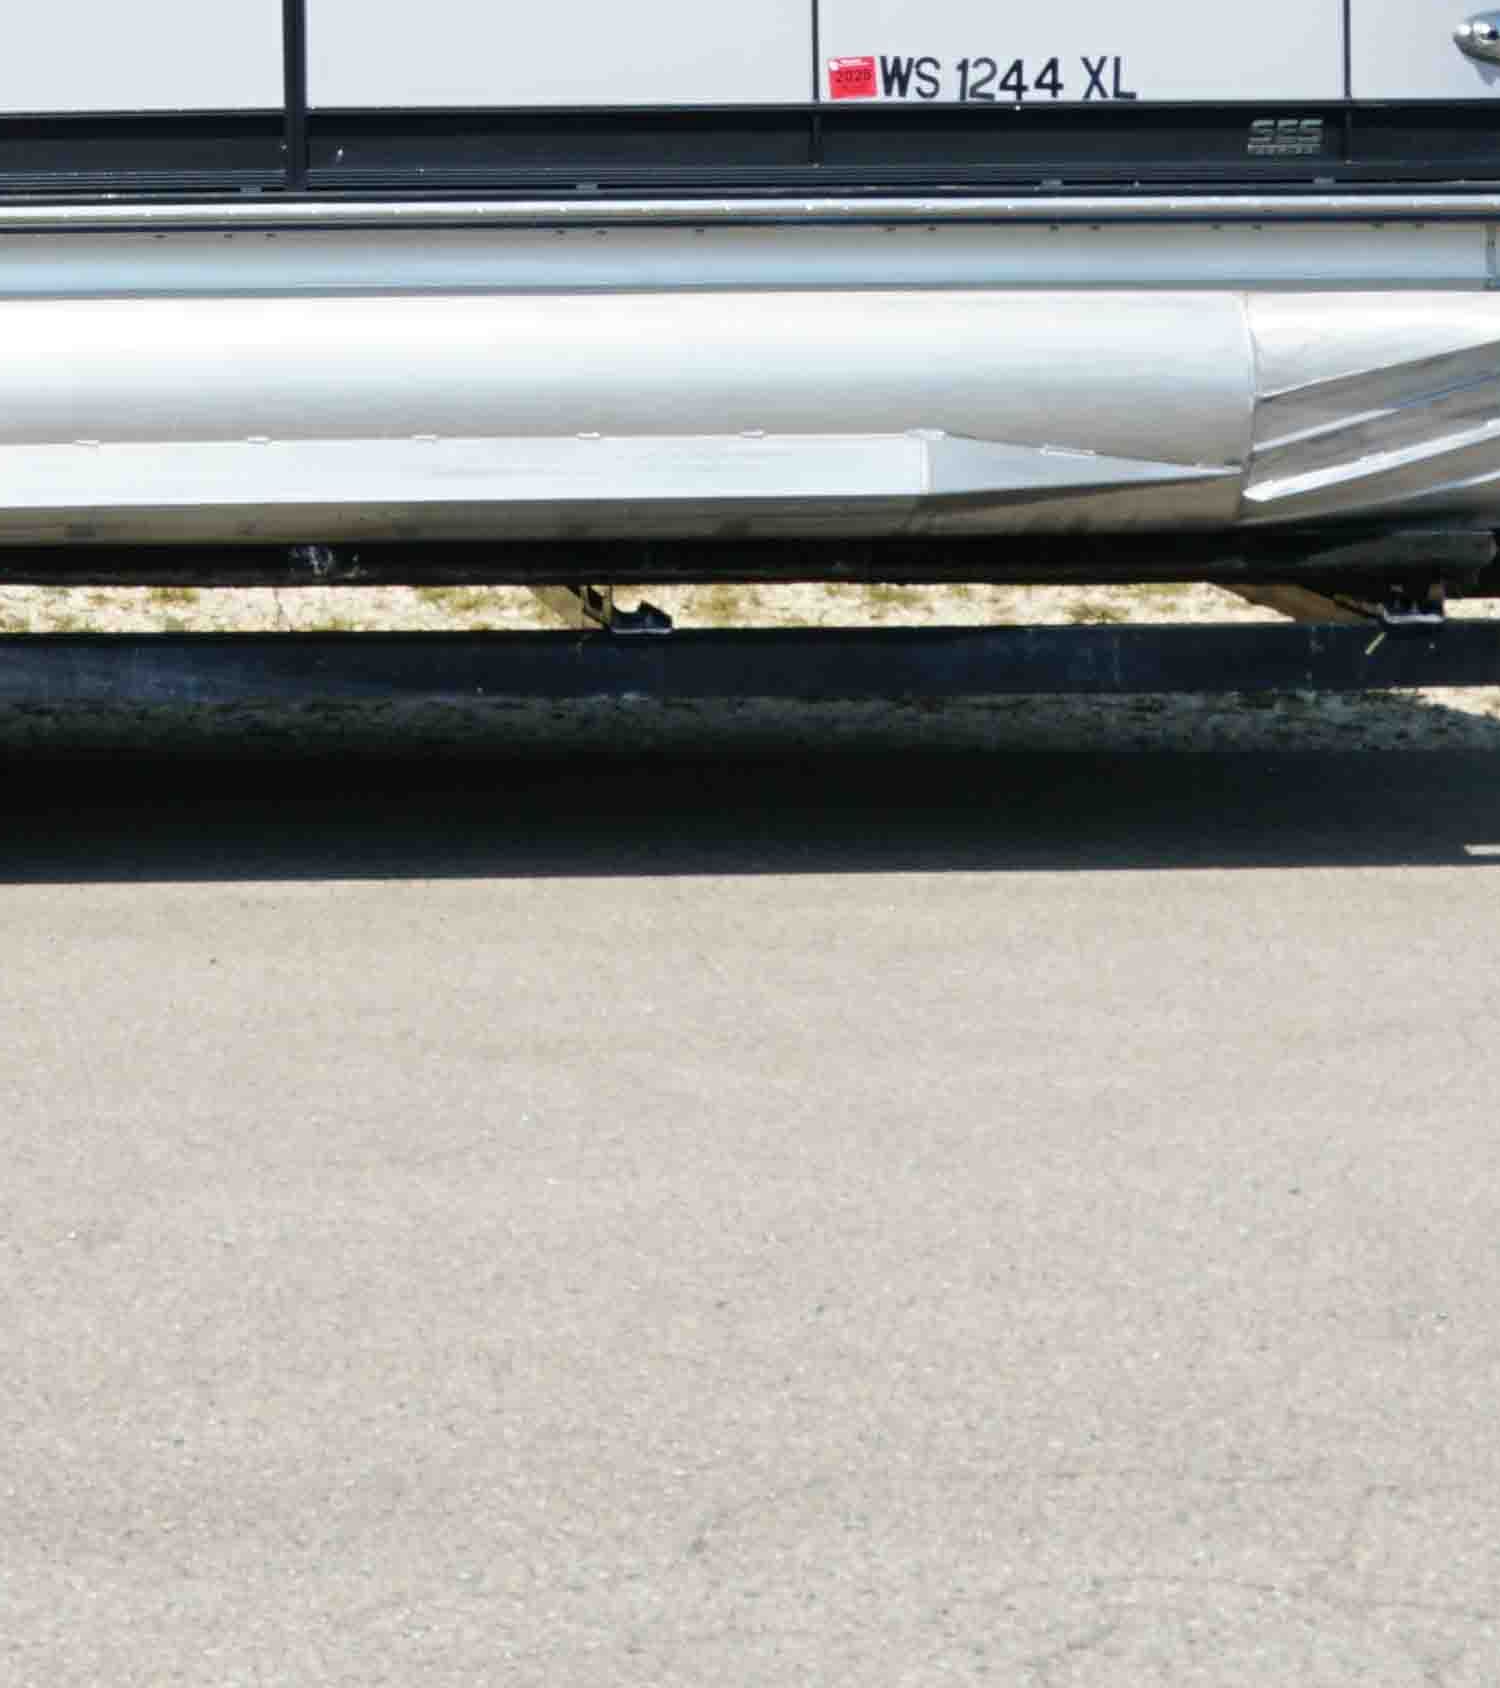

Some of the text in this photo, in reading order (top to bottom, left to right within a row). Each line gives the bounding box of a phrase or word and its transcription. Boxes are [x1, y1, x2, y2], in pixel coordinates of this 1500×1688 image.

[880, 56, 1137, 101] WS 1244 XL
